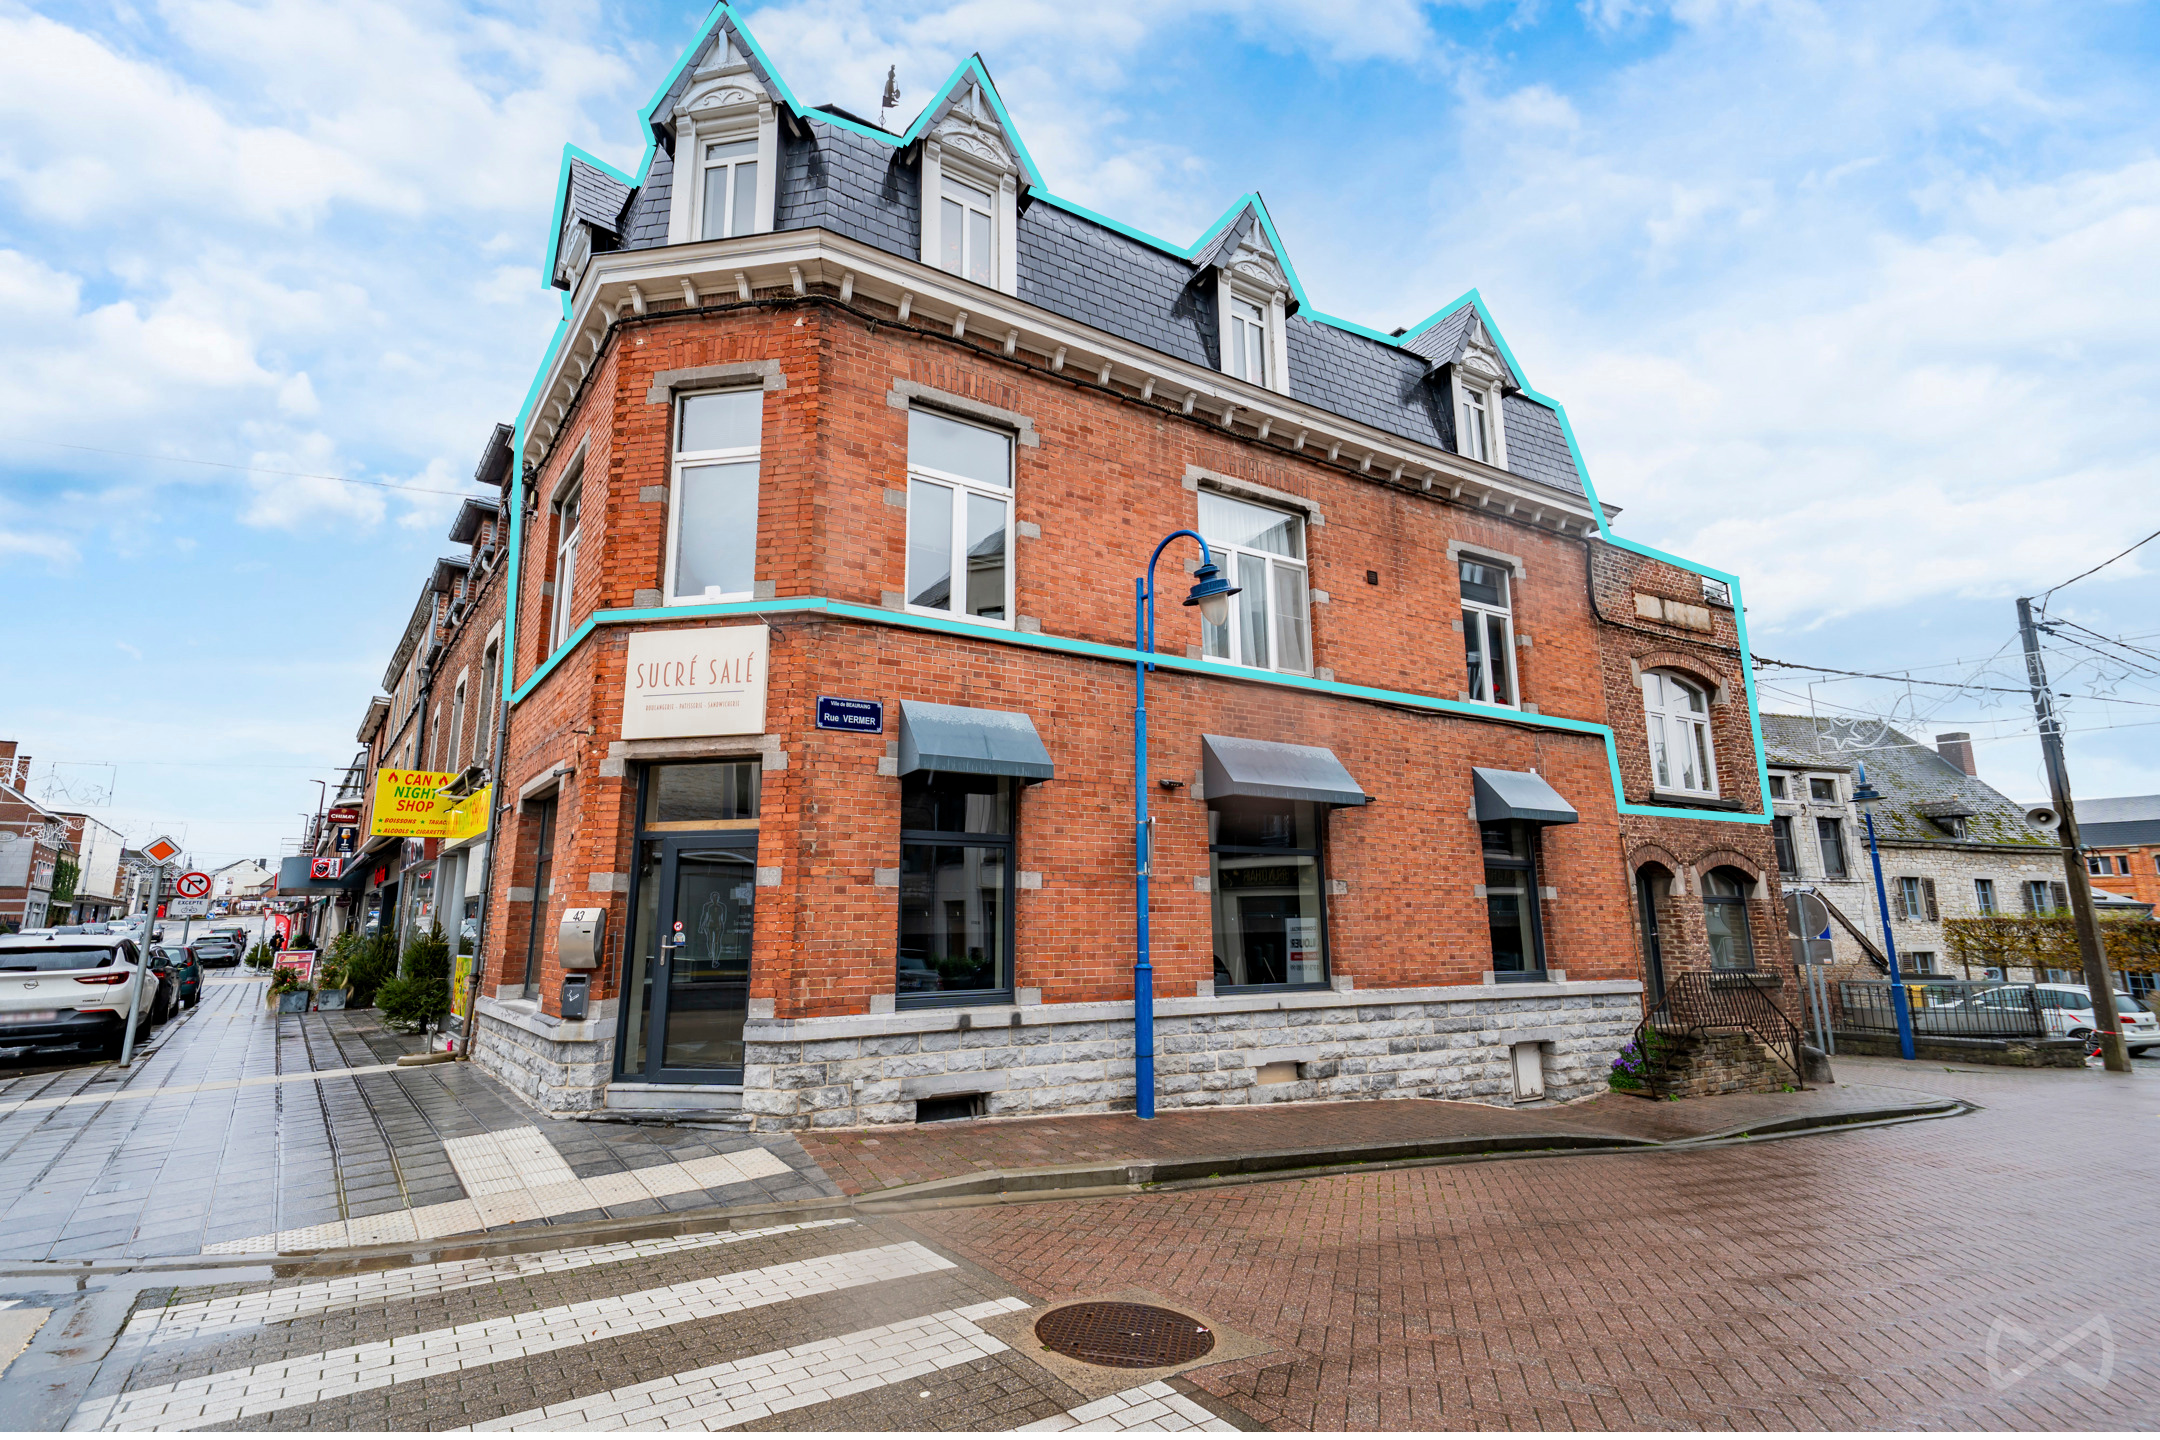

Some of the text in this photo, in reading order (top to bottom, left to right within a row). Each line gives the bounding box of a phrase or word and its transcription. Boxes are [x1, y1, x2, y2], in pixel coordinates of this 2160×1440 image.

[636, 651, 754, 689] SUCRÉ SALÉ
[645, 703, 675, 711] BOULANGERIE
[824, 712, 876, 726] Rue VERMER
[404, 773, 433, 786] CAN
[394, 786, 437, 799] NIGHT
[396, 799, 435, 812] SHOP
[572, 910, 586, 922] 43
